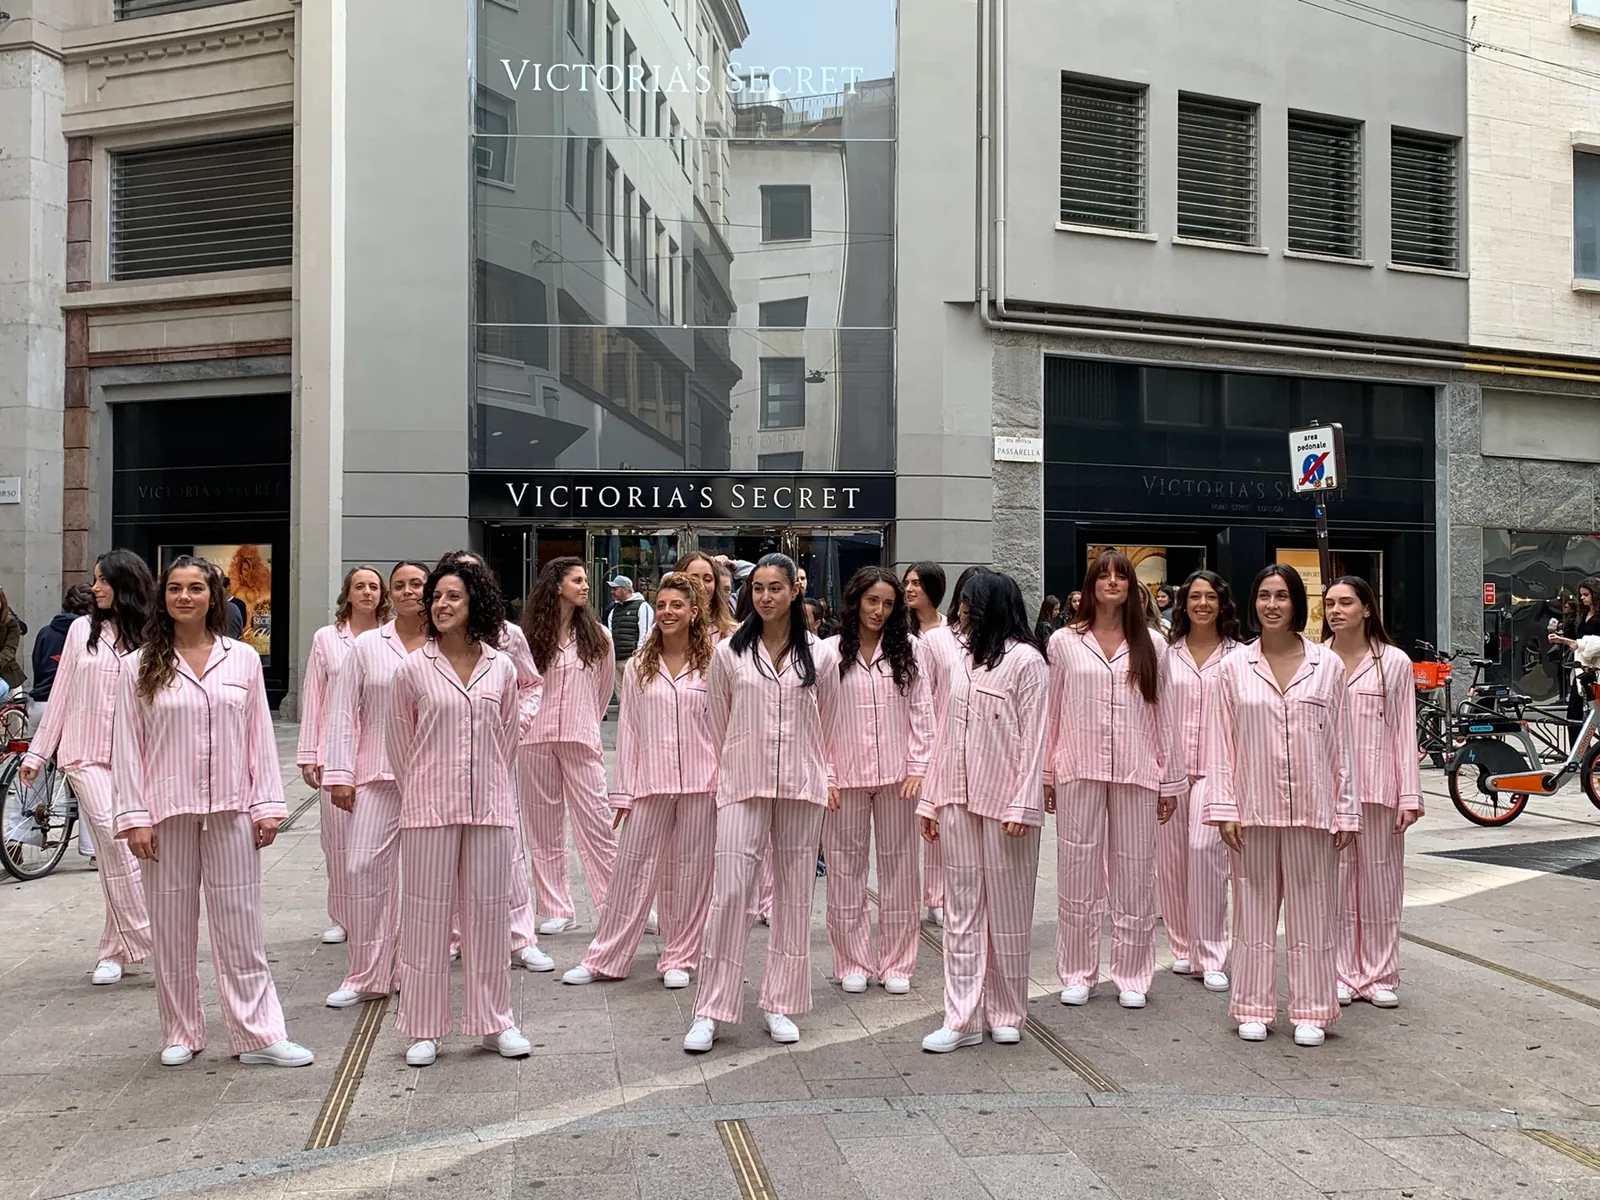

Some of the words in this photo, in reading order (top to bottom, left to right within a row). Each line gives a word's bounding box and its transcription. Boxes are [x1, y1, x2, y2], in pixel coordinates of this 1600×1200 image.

[500, 58, 711, 93] VICTORIA'S
[725, 62, 864, 94] SECRET
[997, 447, 1041, 457] PASSARELLA
[1297, 441, 1327, 452] pedonale
[506, 482, 713, 508] VICTORIA'S
[731, 483, 860, 509] SECRET
[1141, 475, 1265, 500] VICTORIA'S
